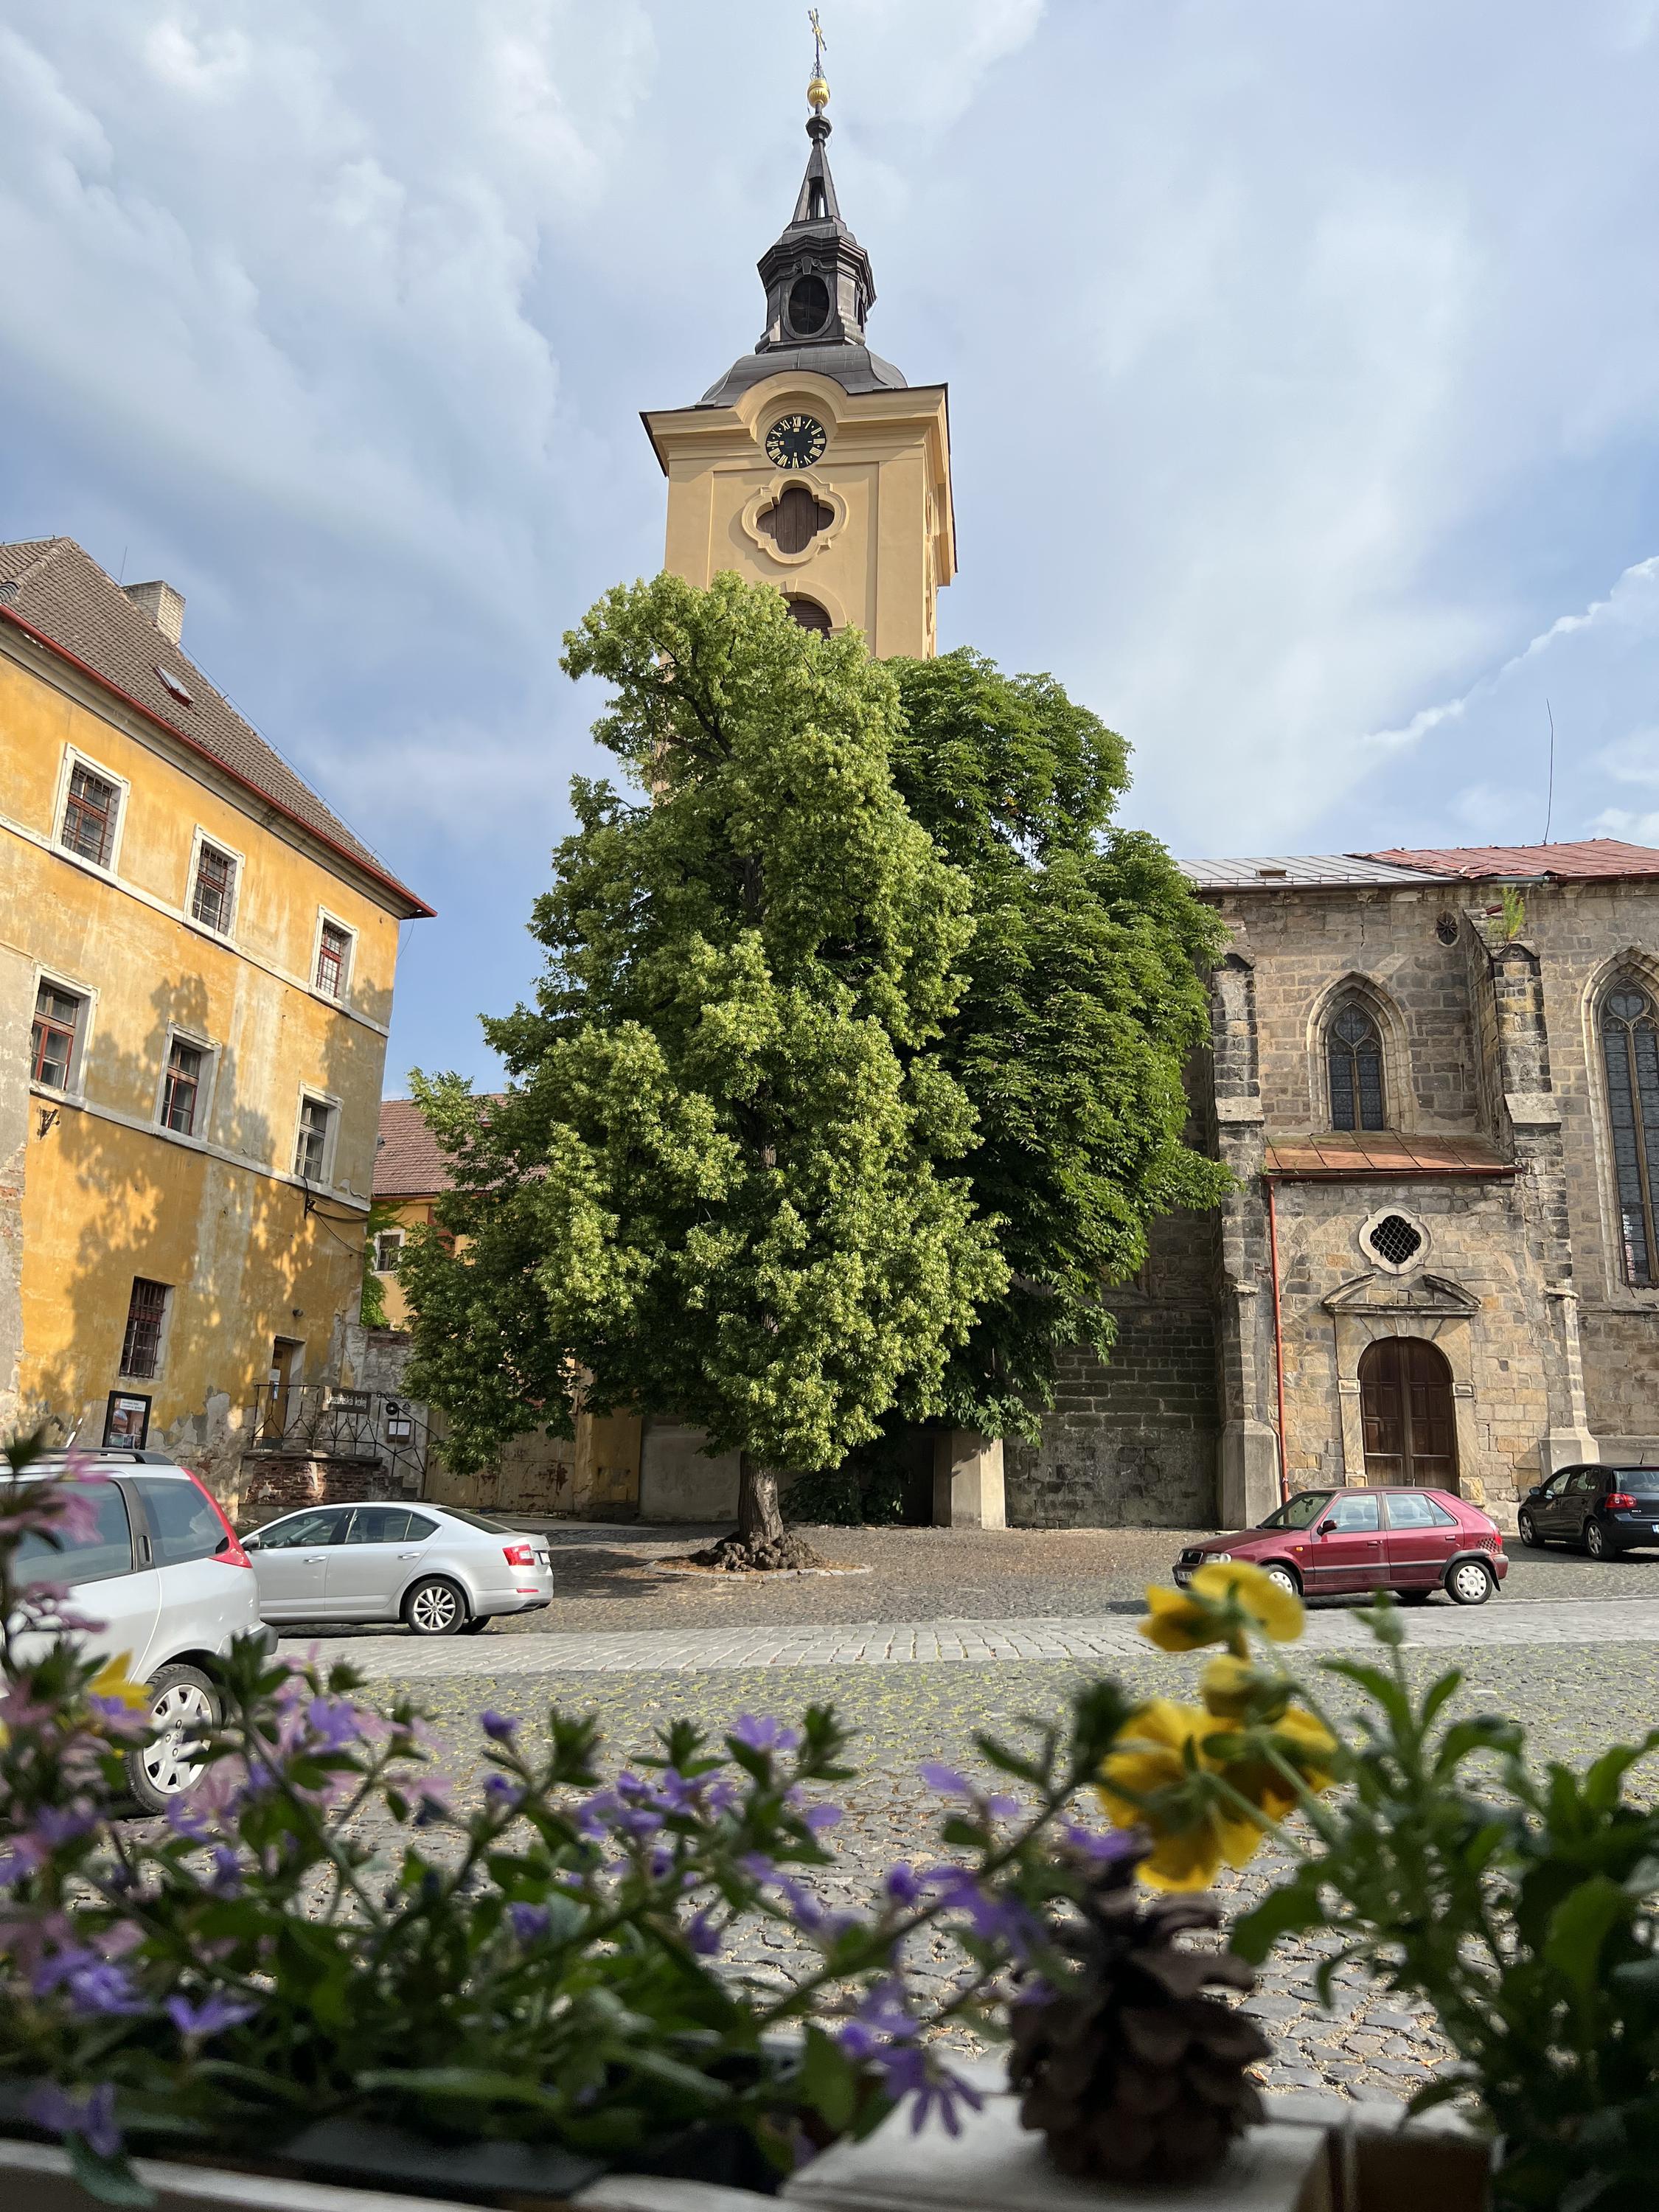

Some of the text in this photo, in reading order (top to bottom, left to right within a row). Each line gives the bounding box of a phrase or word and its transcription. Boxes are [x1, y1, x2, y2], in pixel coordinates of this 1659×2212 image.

[779, 419, 790, 431] XI
[793, 416, 801, 427] XII
[771, 429, 782, 437] X
